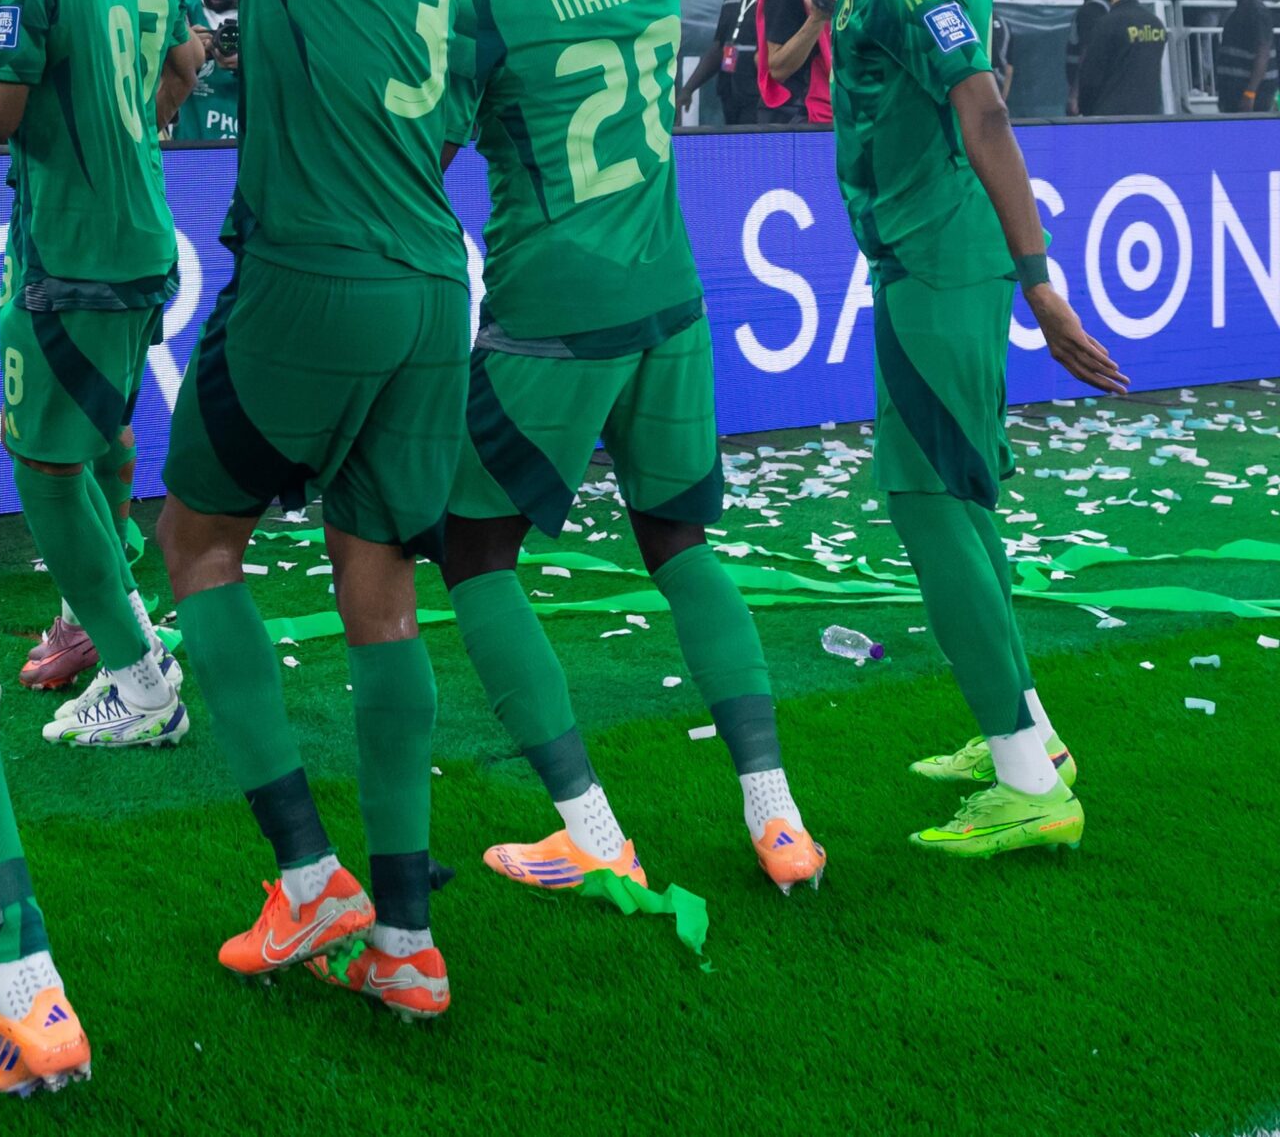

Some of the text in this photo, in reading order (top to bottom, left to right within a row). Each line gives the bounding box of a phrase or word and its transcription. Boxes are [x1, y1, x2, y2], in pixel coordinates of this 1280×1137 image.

[108, 5, 143, 144] 8
[206, 110, 238, 133] PH
[555, 14, 682, 204] 20
[4, 347, 24, 406] 8
